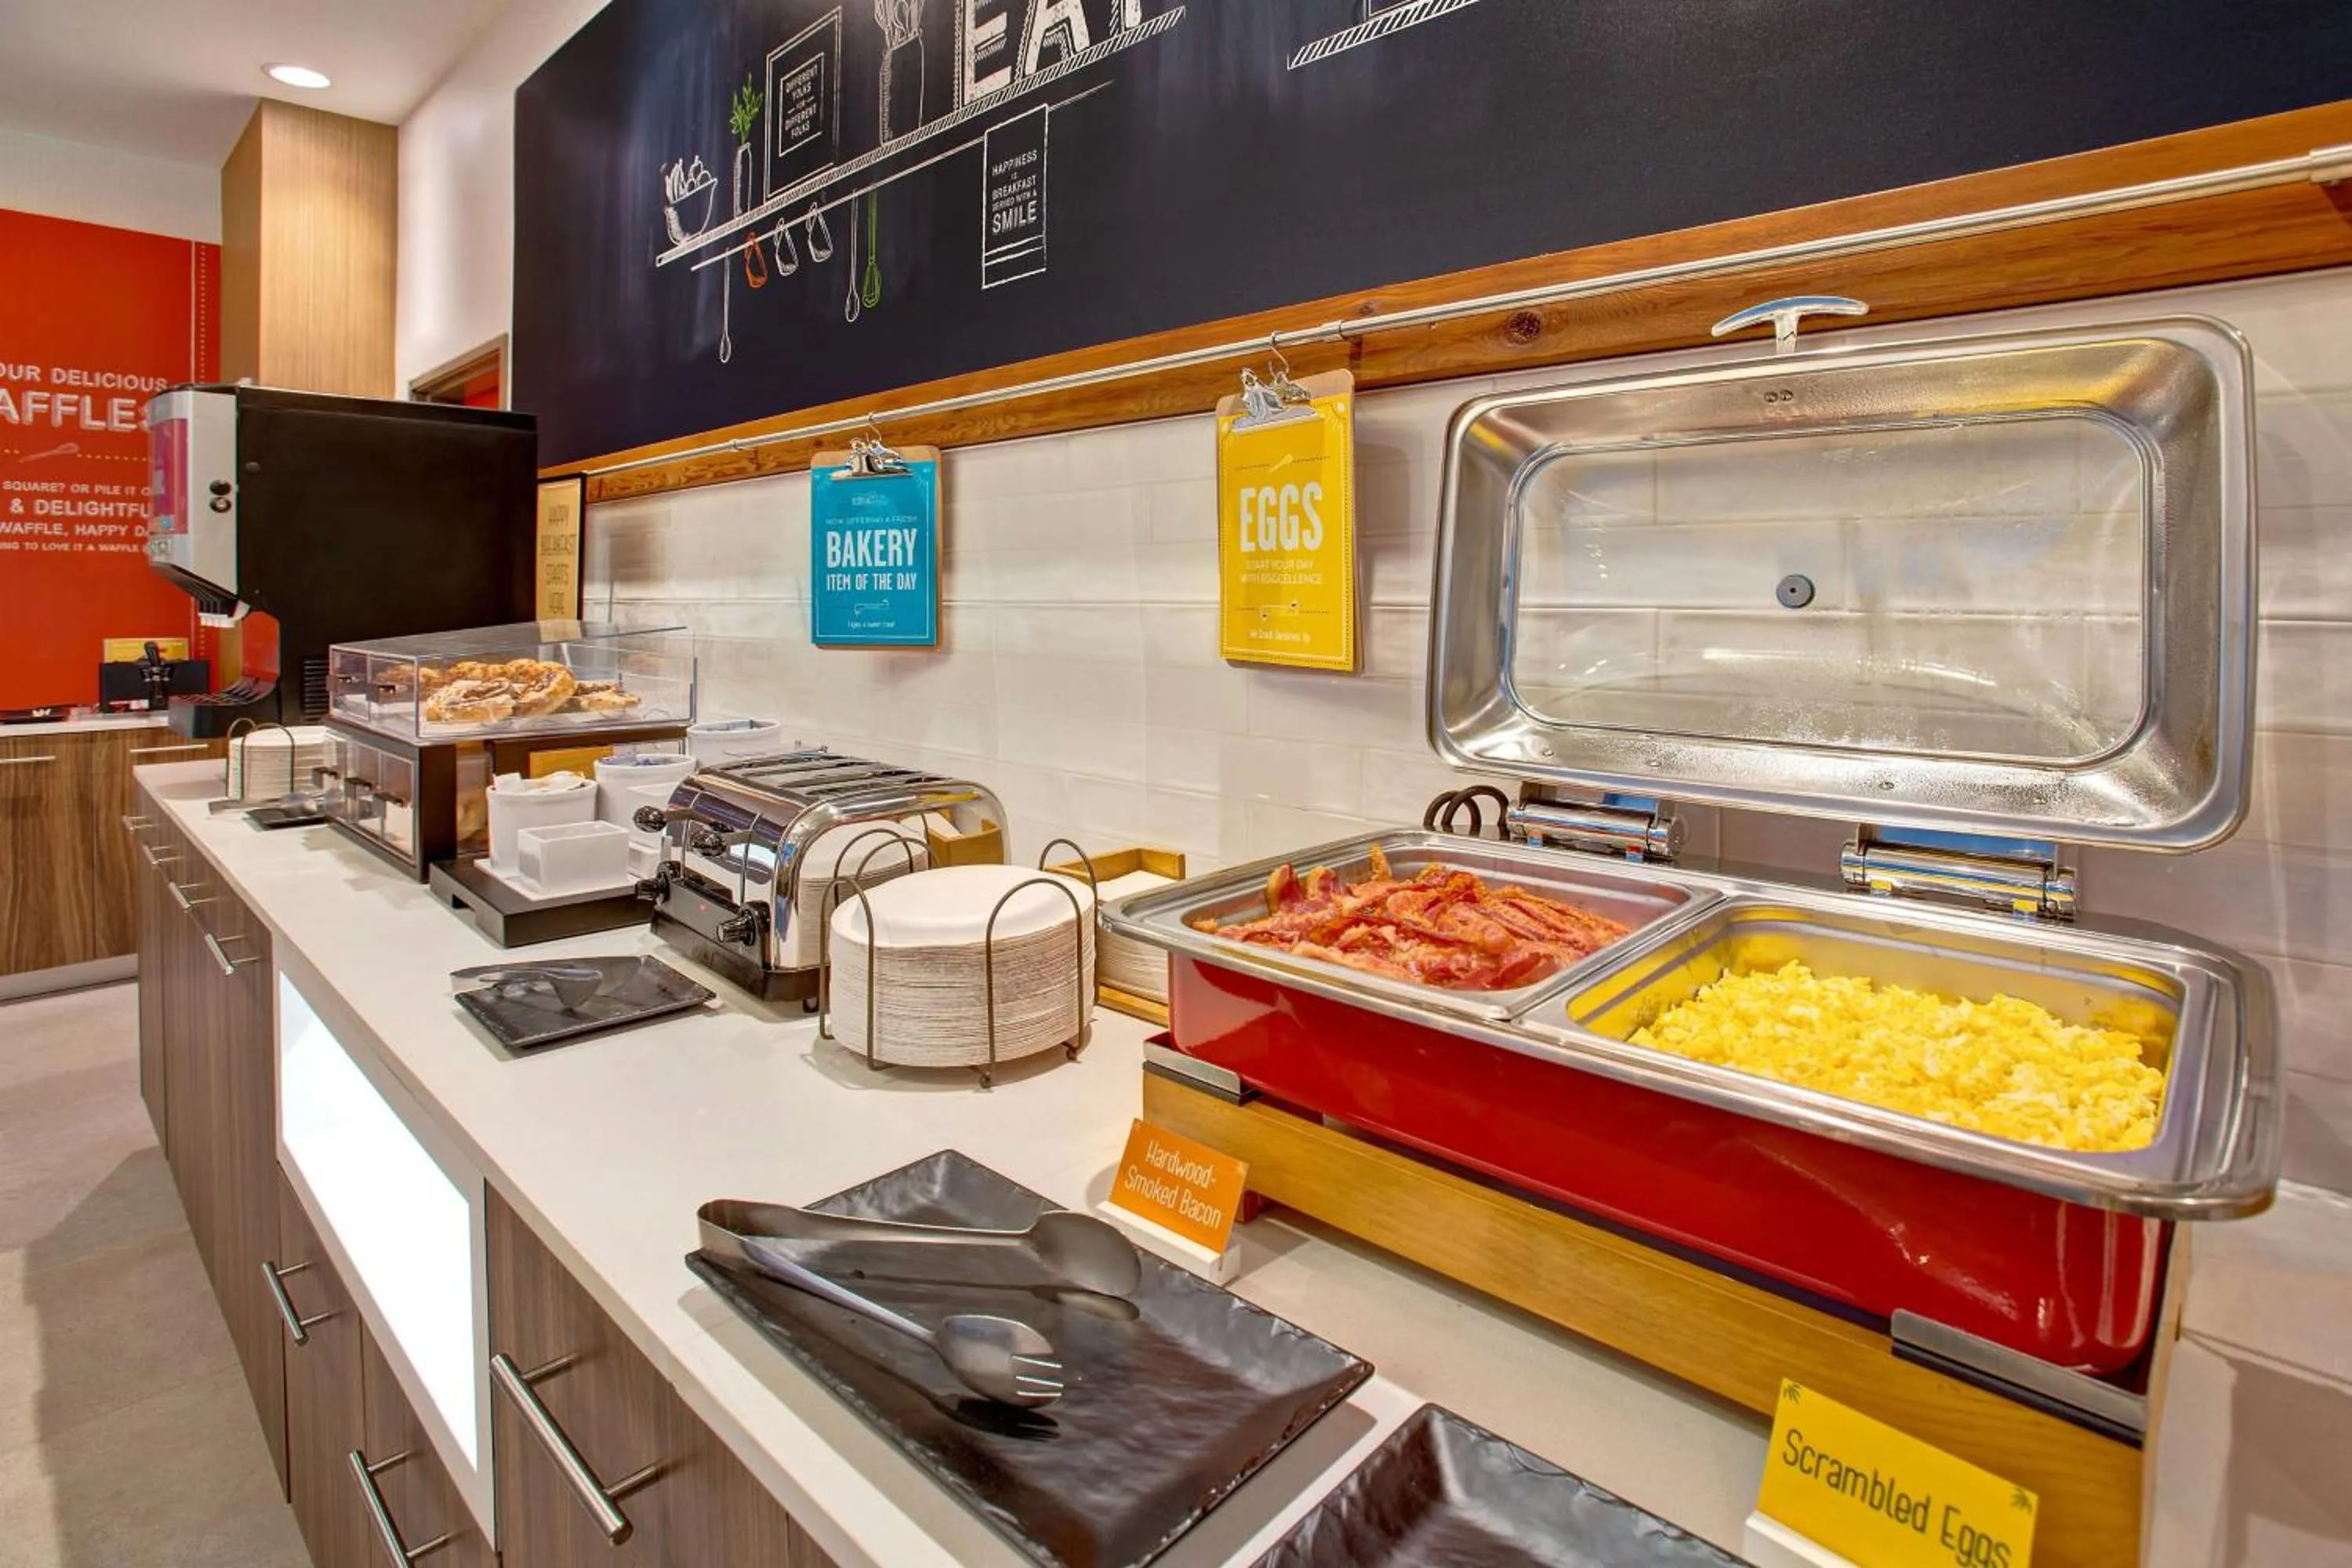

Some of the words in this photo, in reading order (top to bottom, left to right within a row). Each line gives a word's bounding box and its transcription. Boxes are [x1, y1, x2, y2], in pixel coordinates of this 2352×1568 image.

[785, 103, 816, 132] DIFFERENT
[791, 120, 810, 140] FOLKS
[992, 149, 1037, 176] HAPPINESS
[992, 175, 1036, 201] BREAKFAST
[992, 200, 1037, 234] SMILE
[51, 367, 168, 392] DELICIOUS
[0, 388, 152, 433] AFFLE
[2, 481, 65, 494] SQUARE?
[70, 483, 90, 495] OR
[94, 485, 121, 495] PILE
[125, 486, 136, 495] IT
[10, 498, 24, 515] &
[1240, 481, 1323, 553] EGGS
[75, 524, 128, 537] HAPPY
[24, 541, 38, 551] TO
[42, 543, 70, 552] LOVE
[827, 528, 917, 568] BAKERY
[827, 574, 851, 591] ITEM
[855, 574, 869, 590] OF
[873, 573, 892, 590] THE
[897, 572, 917, 590] DAY
[1145, 1140, 1217, 1189] Hardwood-
[1124, 1165, 1179, 1209] Smoked
[1179, 1189, 1221, 1229] Bacon
[1782, 1428, 1932, 1535] Scrambled
[1940, 1504, 2013, 1568] Eggs
